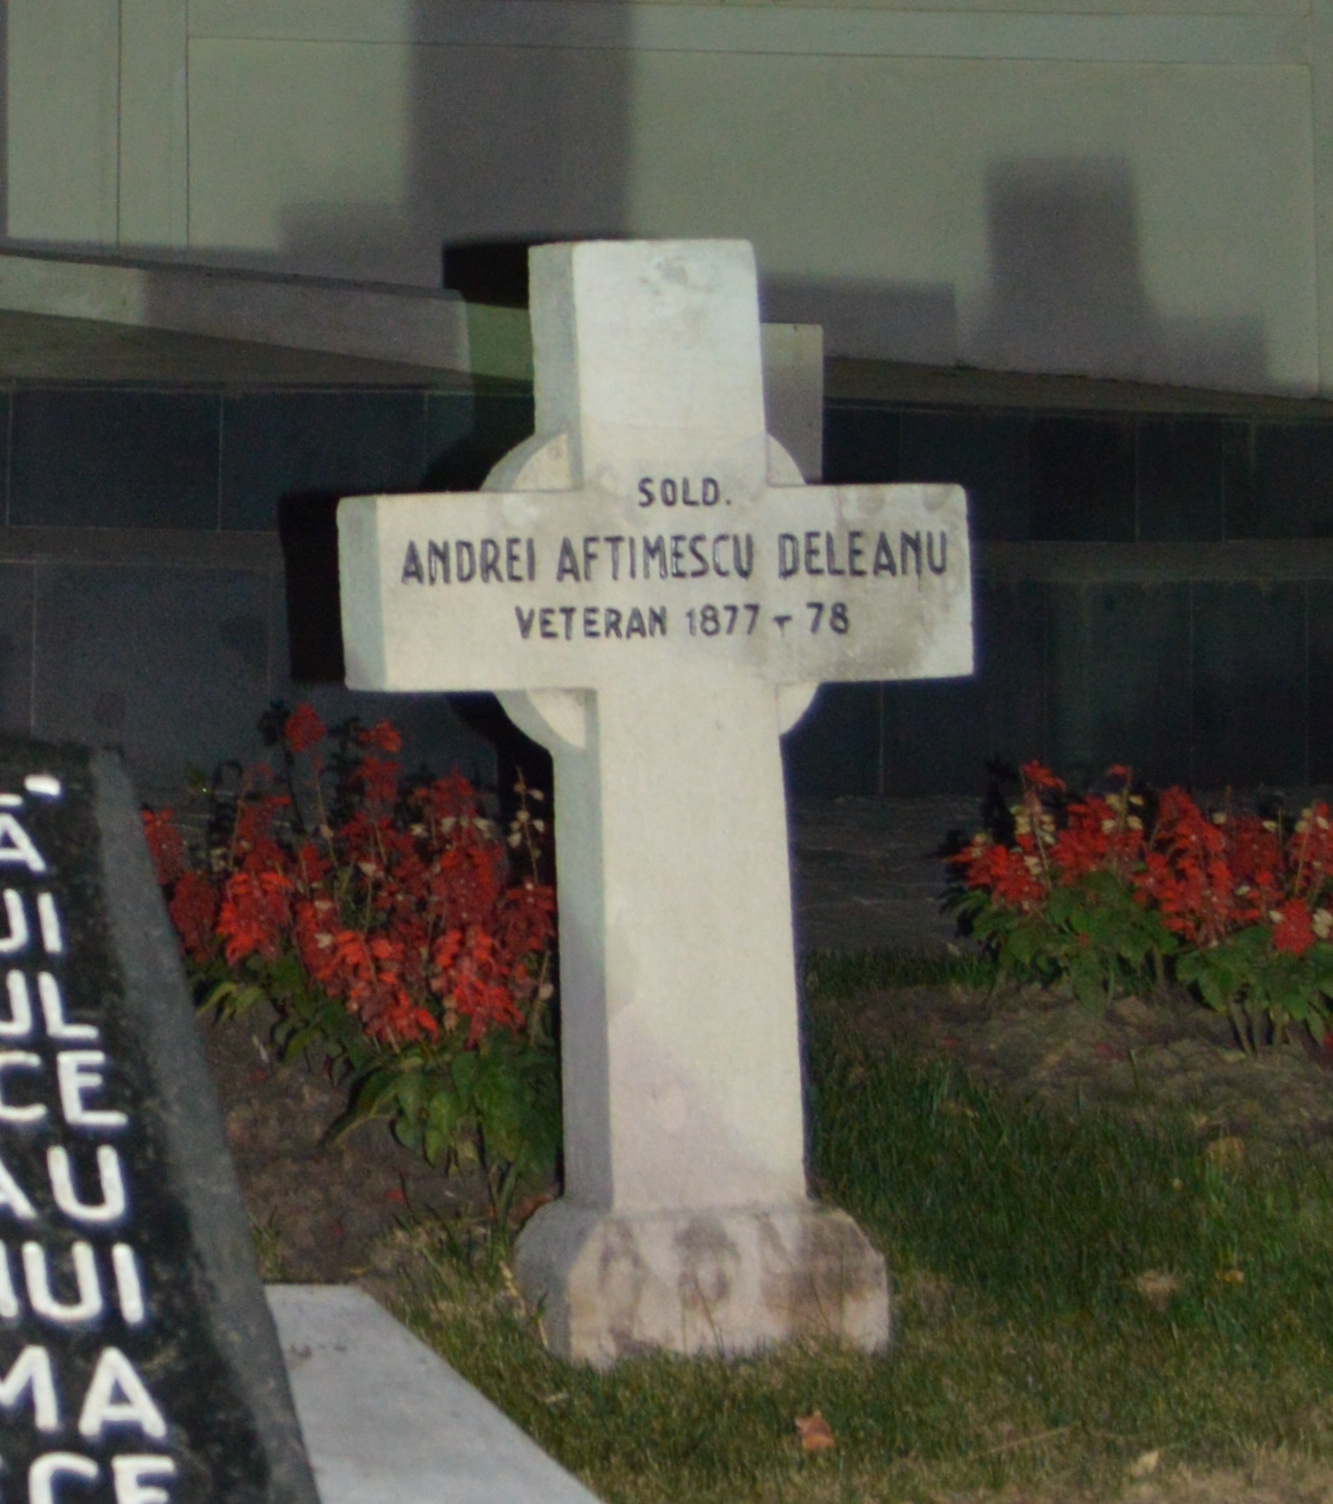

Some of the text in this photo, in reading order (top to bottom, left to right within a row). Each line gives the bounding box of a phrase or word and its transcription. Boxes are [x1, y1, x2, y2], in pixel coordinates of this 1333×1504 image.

[637, 476, 733, 508] SOLD.
[400, 530, 949, 586] ANDREI AFTIMESCU DELEANU
[514, 605, 668, 641] VETERAN
